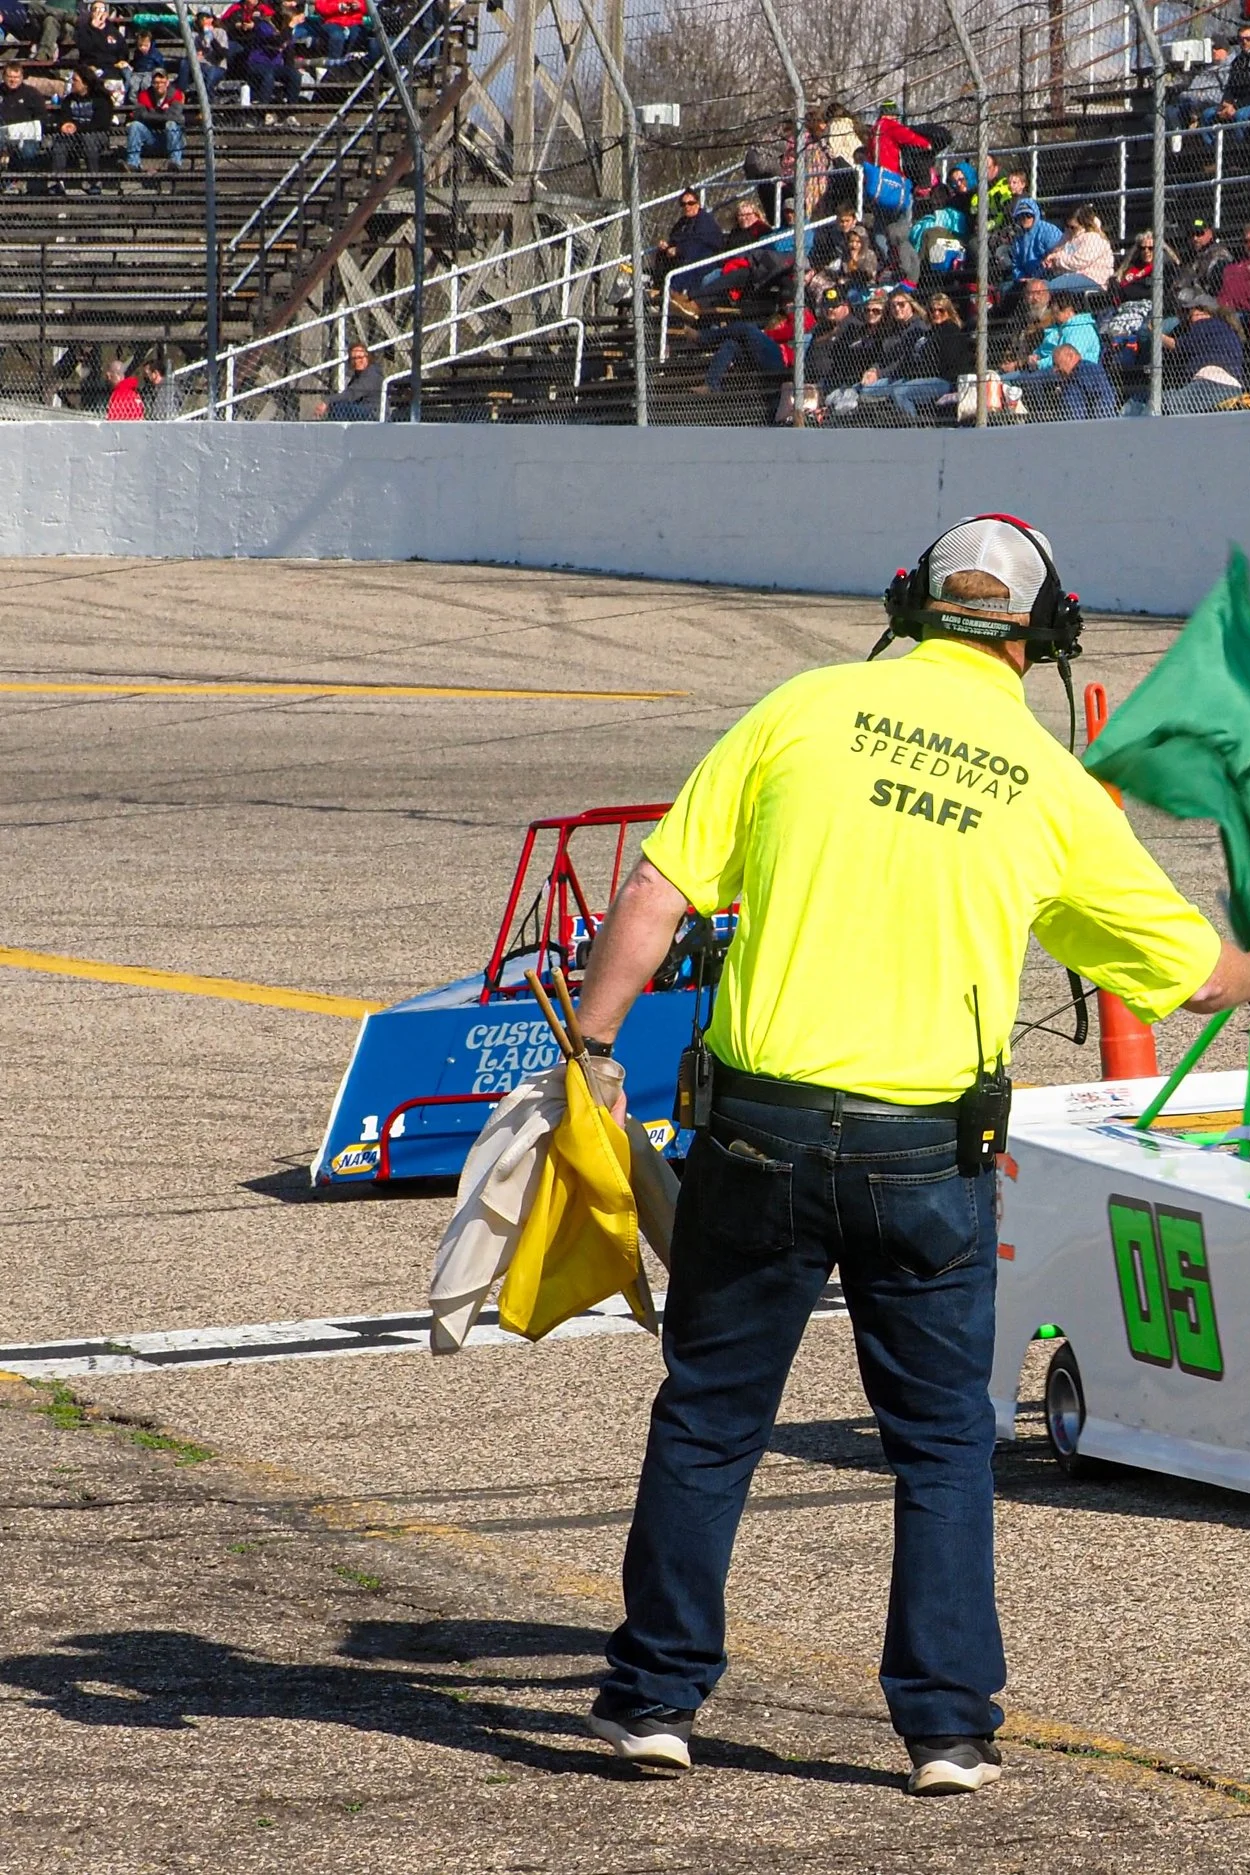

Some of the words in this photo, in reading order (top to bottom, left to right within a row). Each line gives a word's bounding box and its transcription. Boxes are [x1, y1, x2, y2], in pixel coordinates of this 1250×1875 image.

[854, 711, 1029, 785] KALAMAZOO
[850, 734, 1022, 805] SPEEDWAY
[869, 778, 983, 834] STAFF
[475, 1045, 561, 1073] LAW
[472, 1071, 532, 1094] CA
[649, 1128, 665, 1143] PA
[339, 1151, 378, 1168] NAPA
[1107, 1193, 1224, 1382] 05
